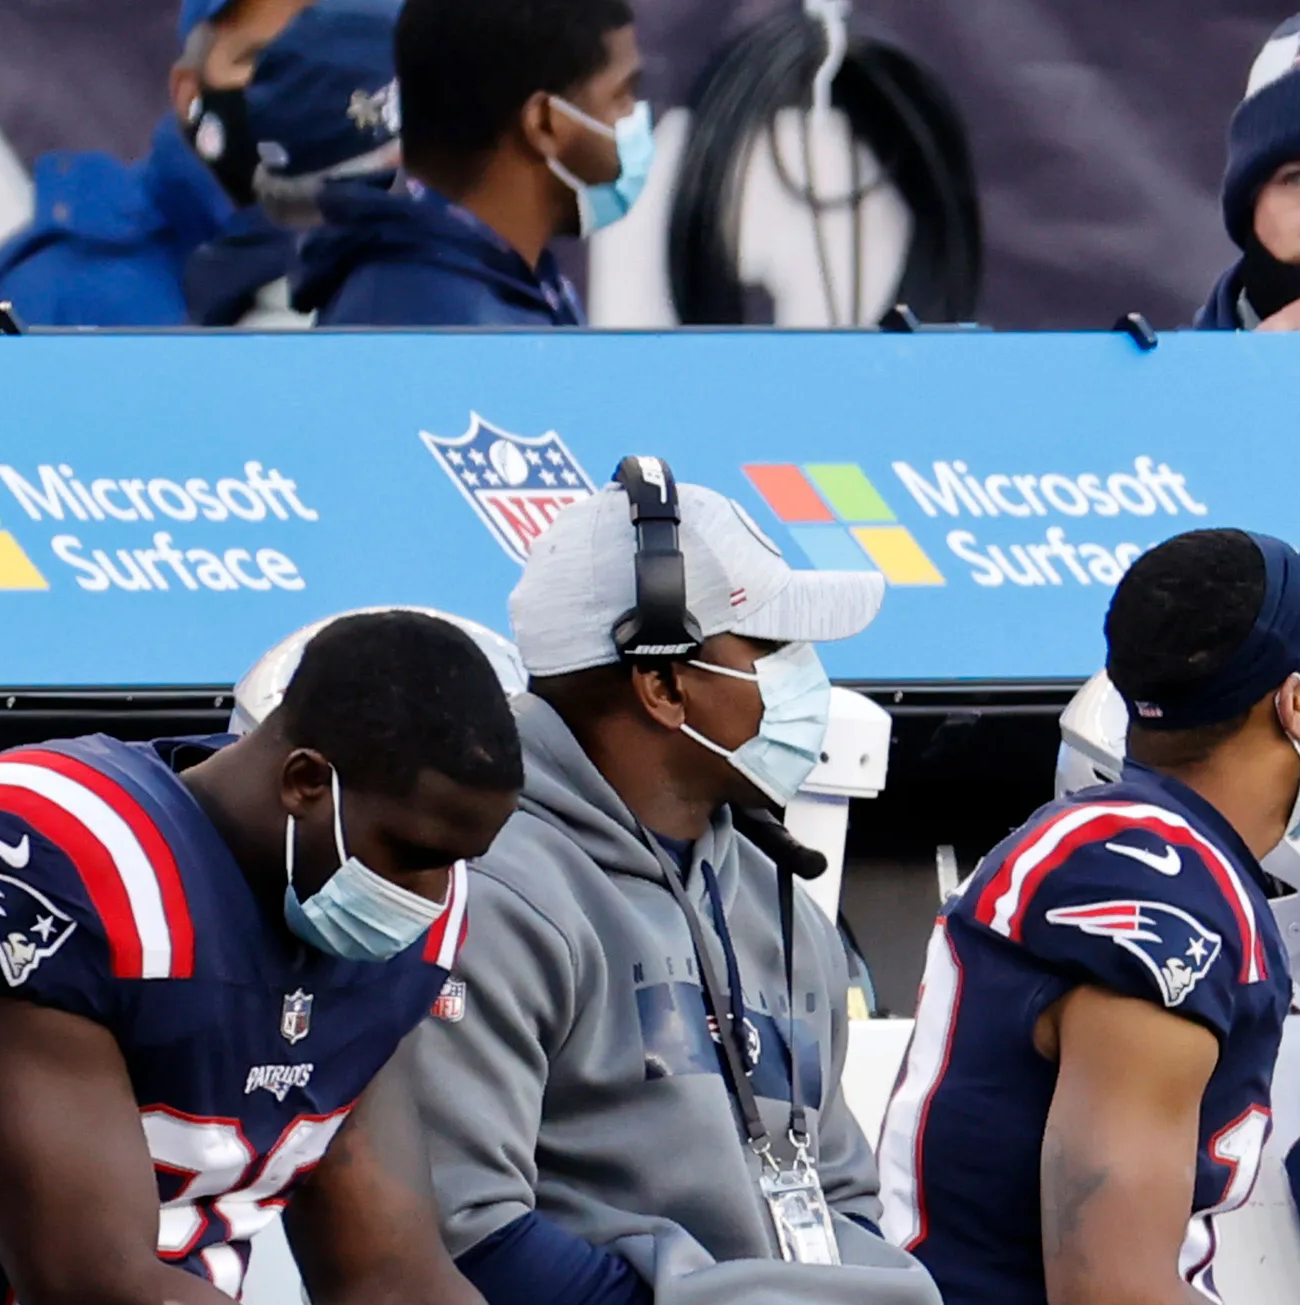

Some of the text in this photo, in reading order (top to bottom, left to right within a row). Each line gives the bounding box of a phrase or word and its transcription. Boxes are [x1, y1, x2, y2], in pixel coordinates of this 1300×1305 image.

[890, 455, 1209, 517] Microsoft
[50, 530, 306, 591] Surface
[244, 1063, 314, 1094] PATRIOTS
